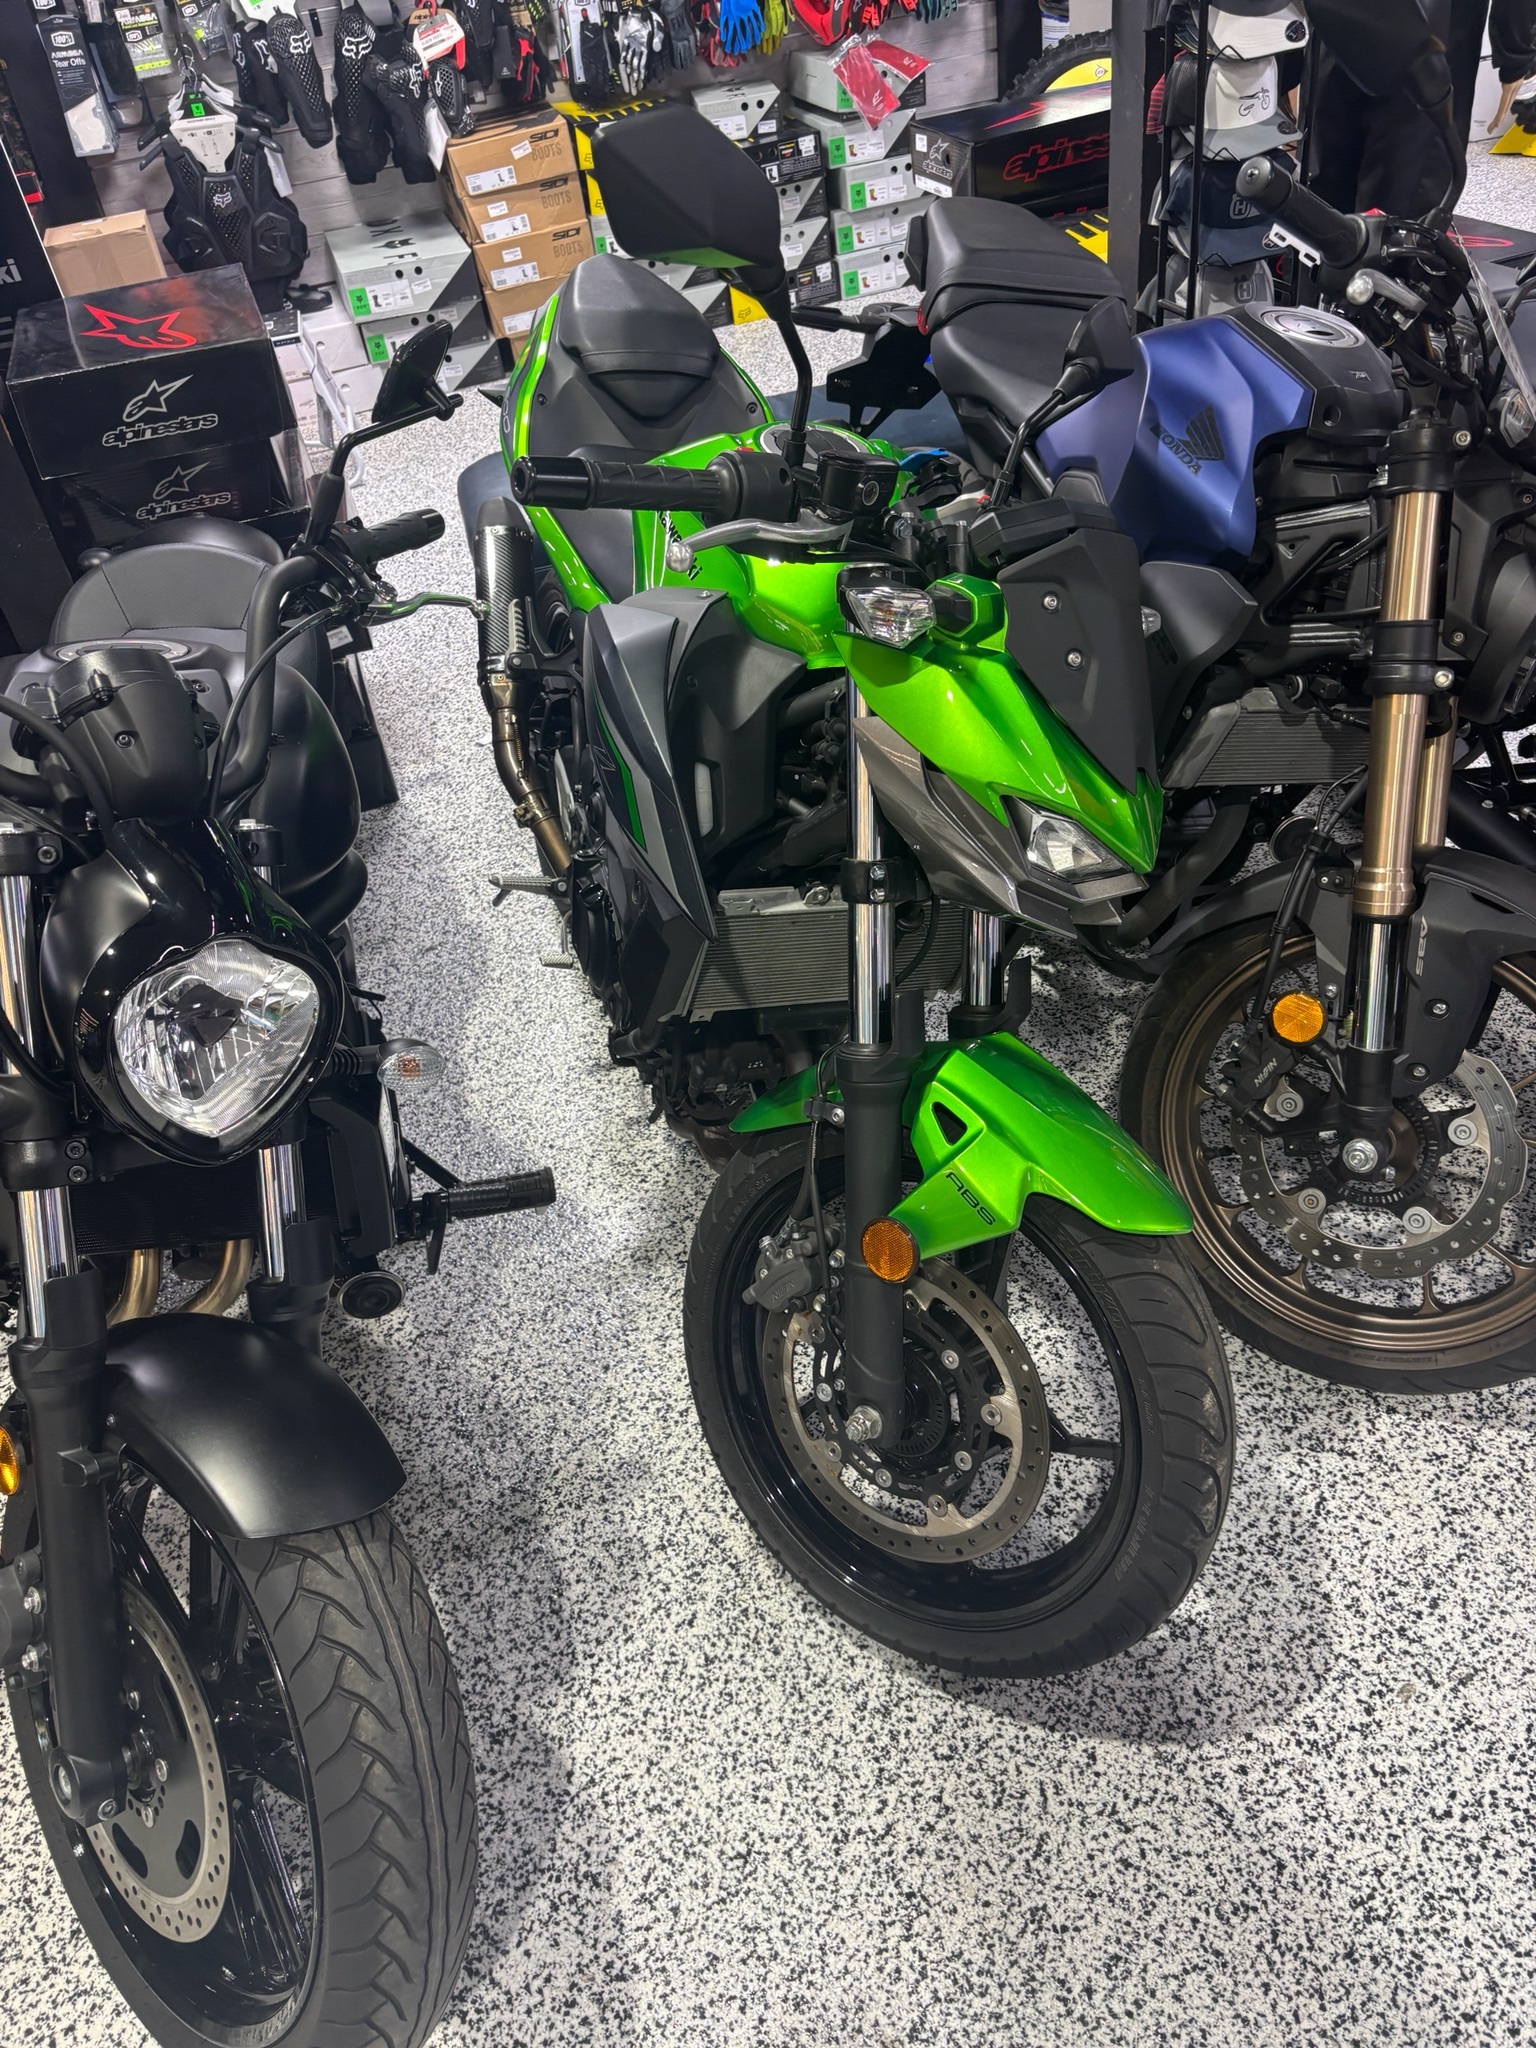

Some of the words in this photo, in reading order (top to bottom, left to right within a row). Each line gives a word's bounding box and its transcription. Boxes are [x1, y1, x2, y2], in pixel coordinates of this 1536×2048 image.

[54, 34, 72, 44] 100%
[53, 59, 69, 68] Tear
[69, 57, 87, 67] Offs
[529, 128, 559, 143] SIDI
[532, 142, 562, 161] BOOTS
[540, 177, 569, 192] SIDI
[542, 190, 571, 209] BOOTS
[552, 227, 581, 241] SIDI
[553, 241, 584, 258] BOOTS
[102, 413, 219, 448] alpinestars
[136, 492, 231, 520] alpinestars
[1415, 914, 1428, 977] ABS
[945, 1171, 996, 1226] ABS
